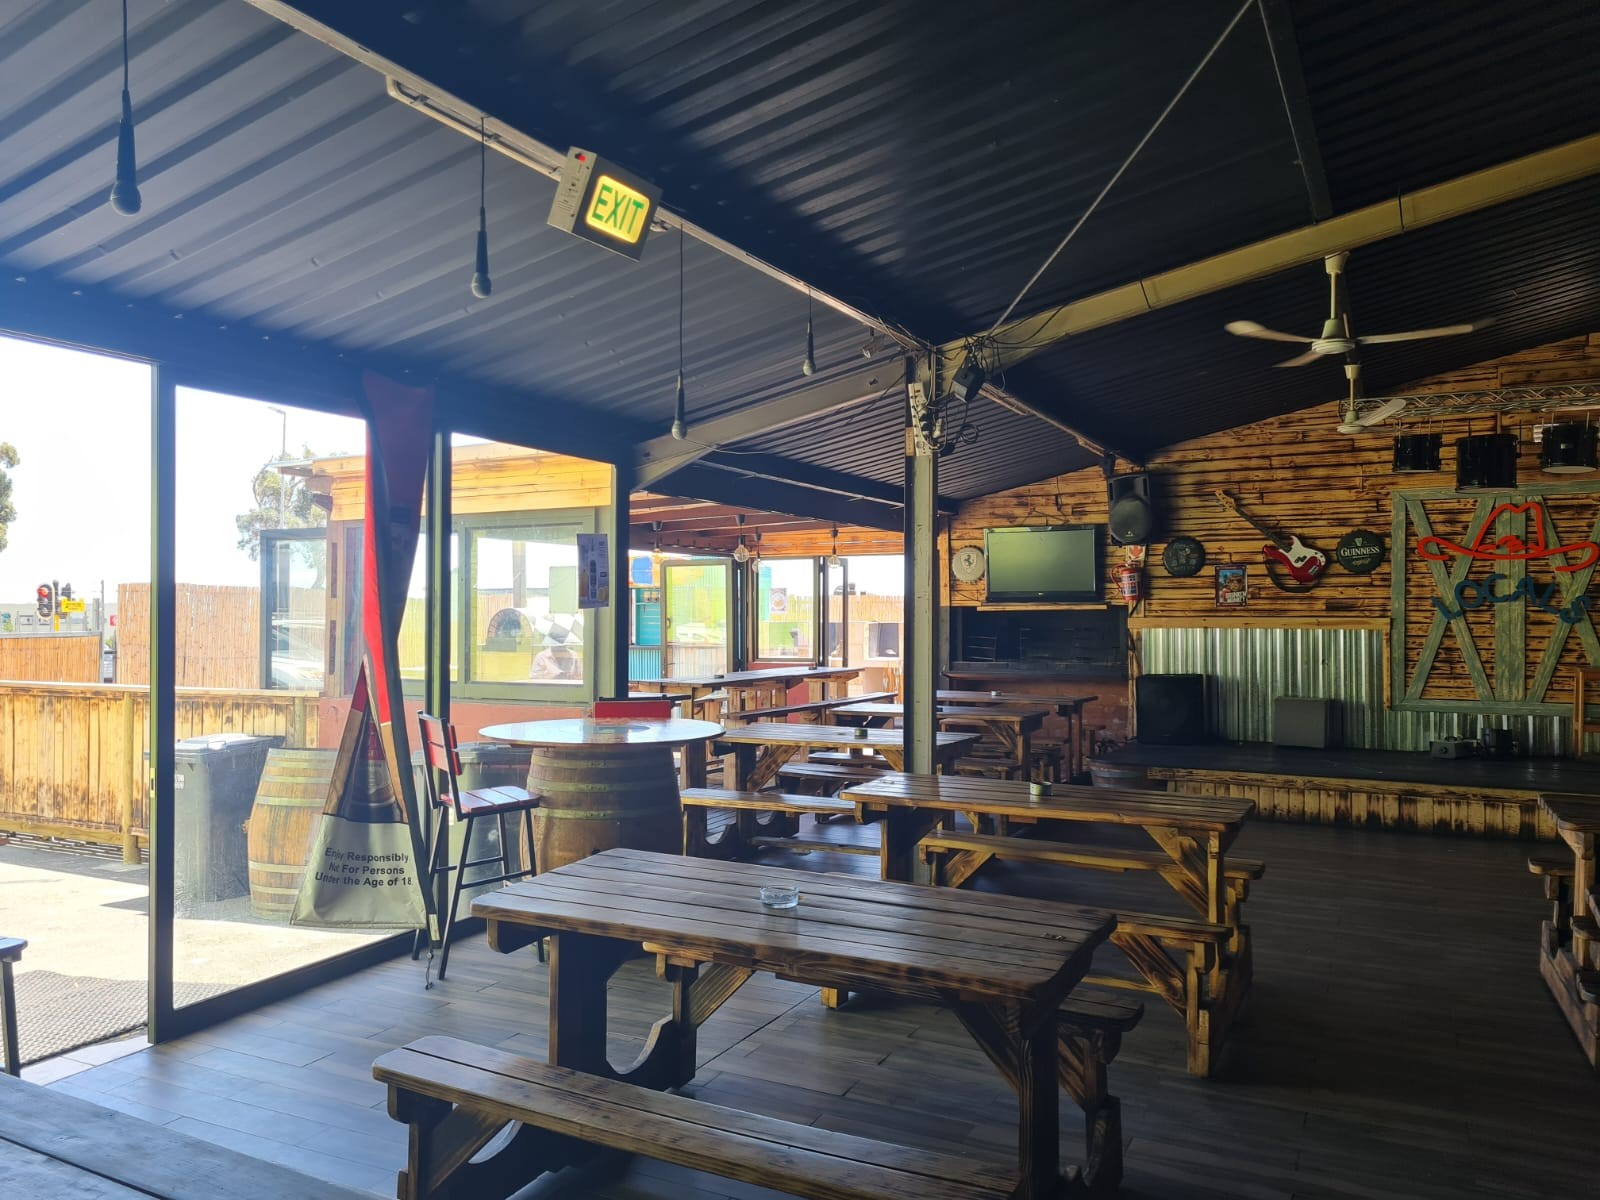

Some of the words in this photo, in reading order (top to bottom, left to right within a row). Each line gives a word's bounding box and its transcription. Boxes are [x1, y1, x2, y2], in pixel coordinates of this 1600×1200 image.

[591, 183, 645, 235] EXIT
[1340, 546, 1380, 557] GUINNESS
[1431, 573, 1592, 625] LOCALS
[347, 851, 409, 863] Responsibly
[342, 864, 360, 874] For
[362, 866, 405, 875] Persons
[343, 876, 360, 886] the
[363, 878, 384, 888] Age
[387, 877, 399, 886] of
